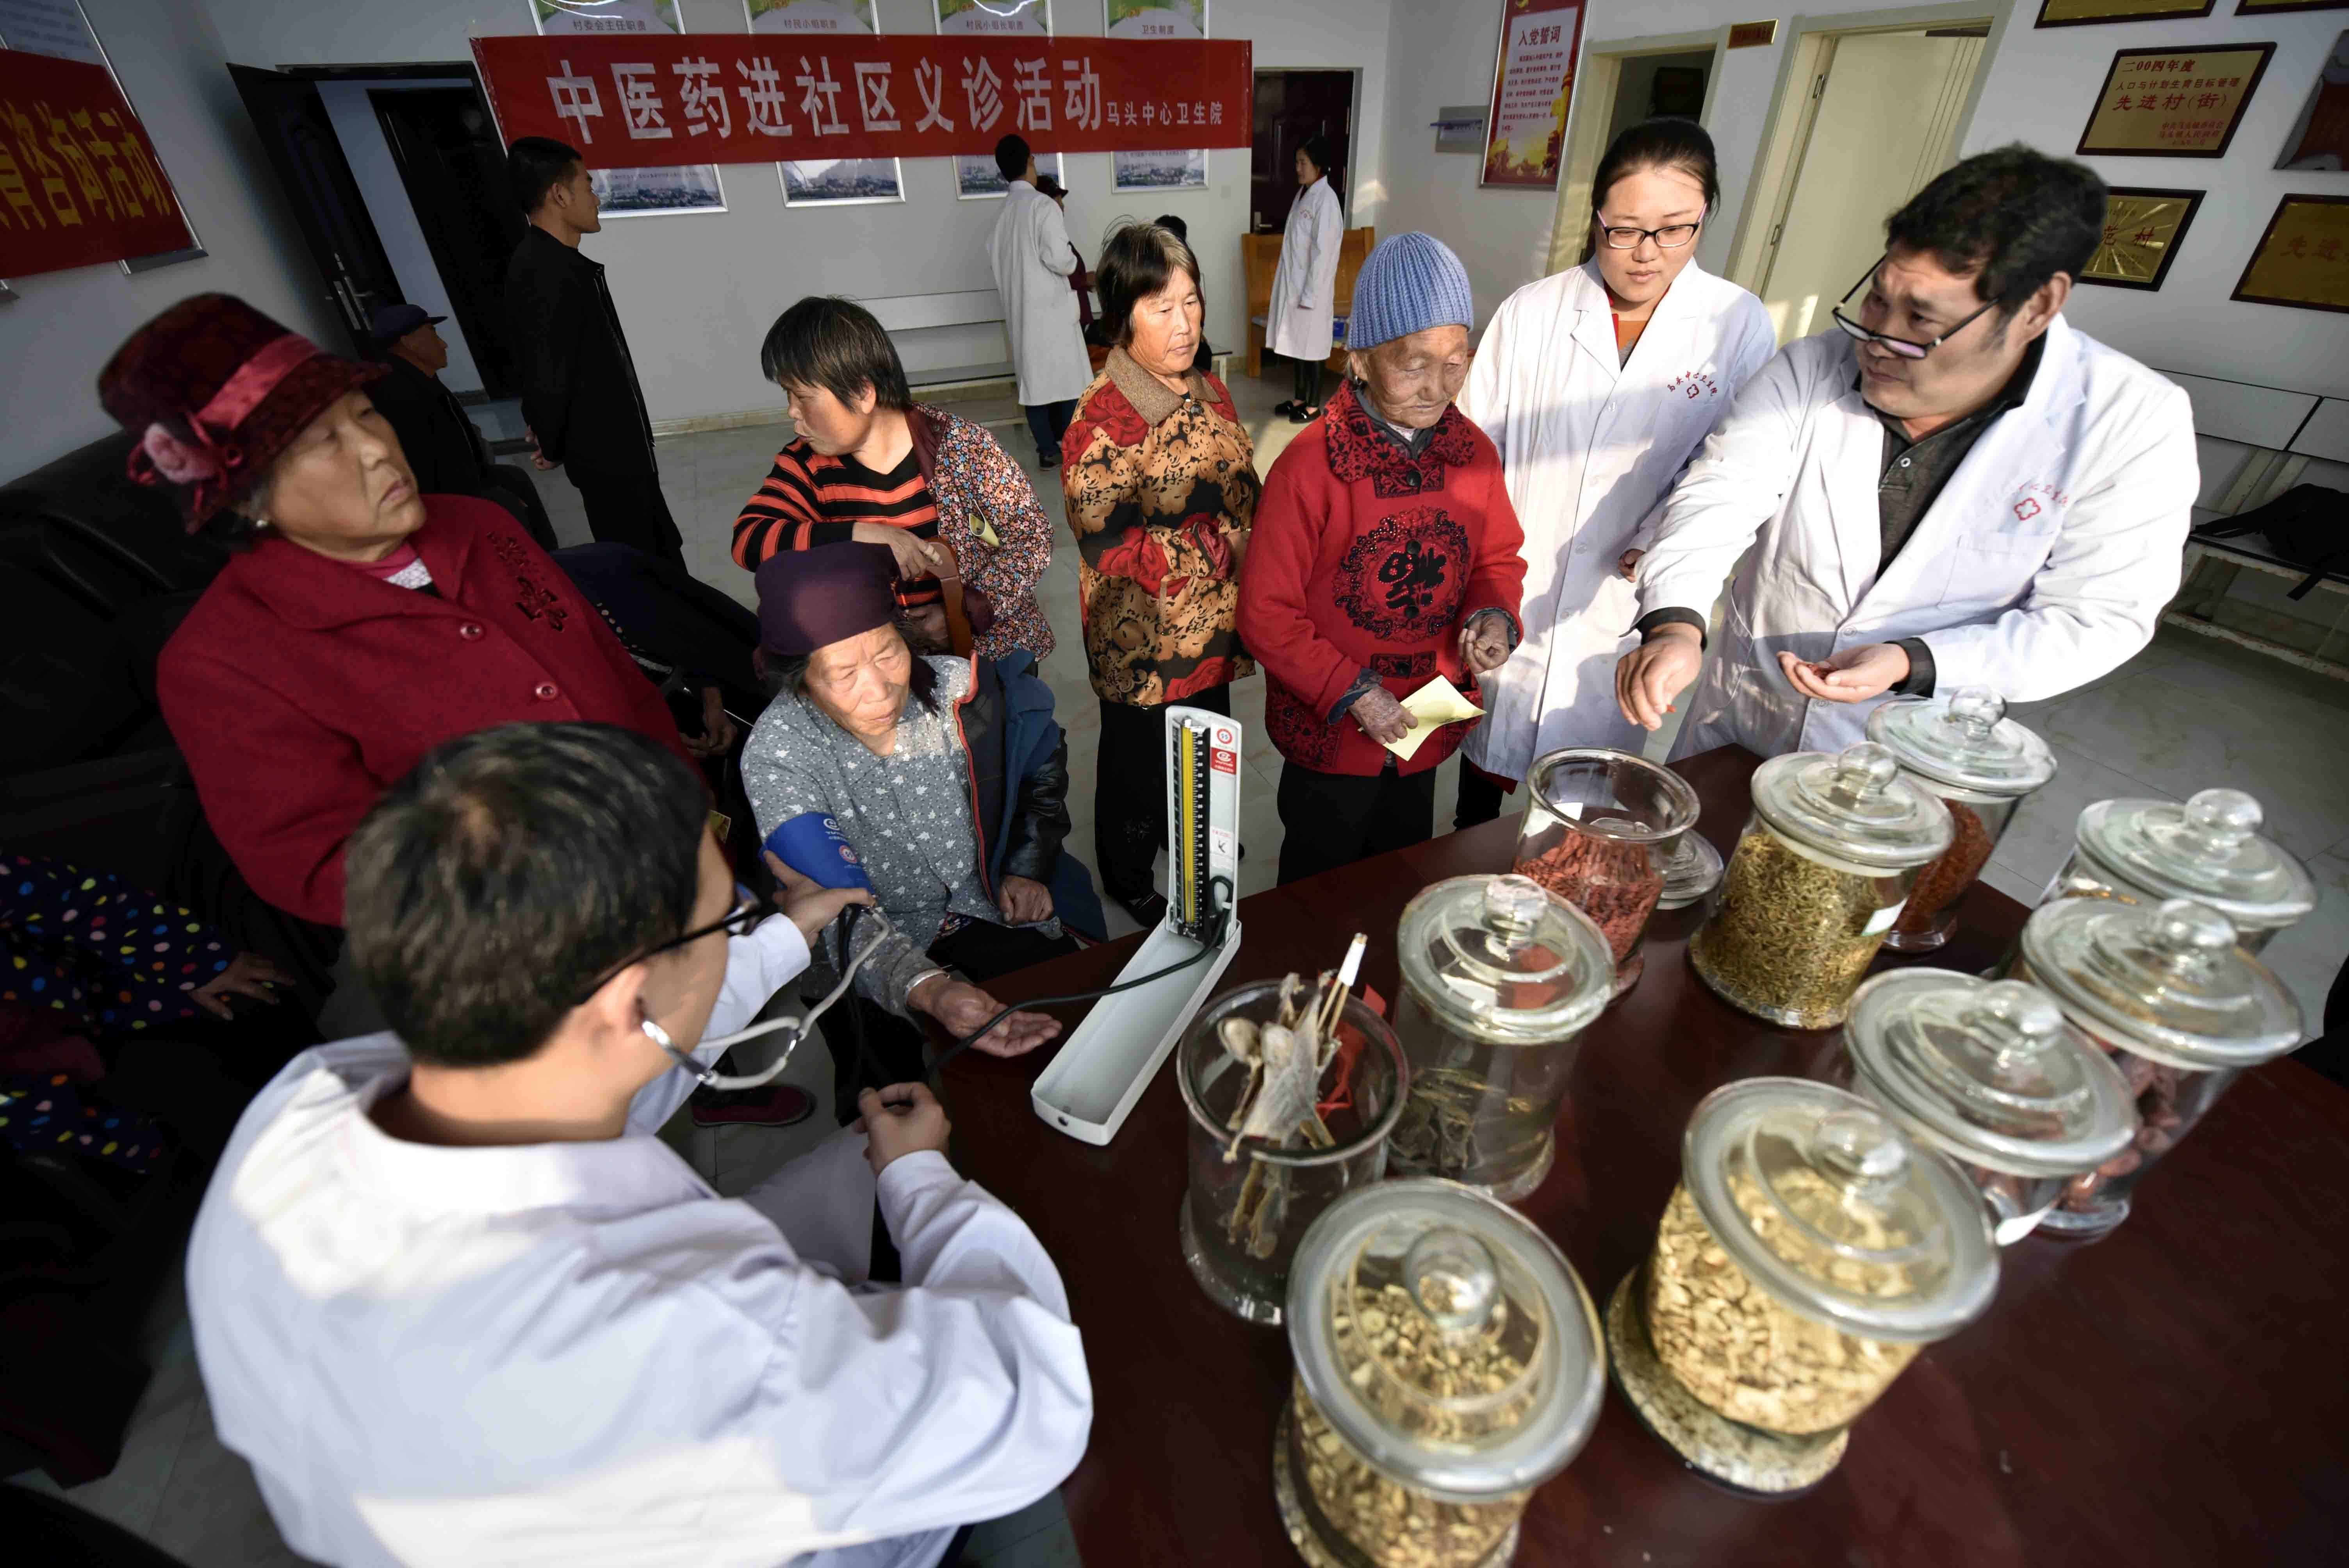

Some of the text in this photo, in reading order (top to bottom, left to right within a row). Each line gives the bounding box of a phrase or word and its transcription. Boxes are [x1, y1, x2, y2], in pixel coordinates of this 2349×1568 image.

[573, 20, 646, 31] 村委会主任职责
[1142, 24, 1175, 36] 卫生制度
[1518, 25, 1561, 47] 入党誓词
[547, 56, 1102, 144] 中医药进社区义诊活动
[1107, 101, 1223, 127] 马头中心卫生院
[2280, 234, 2349, 263] 先进
